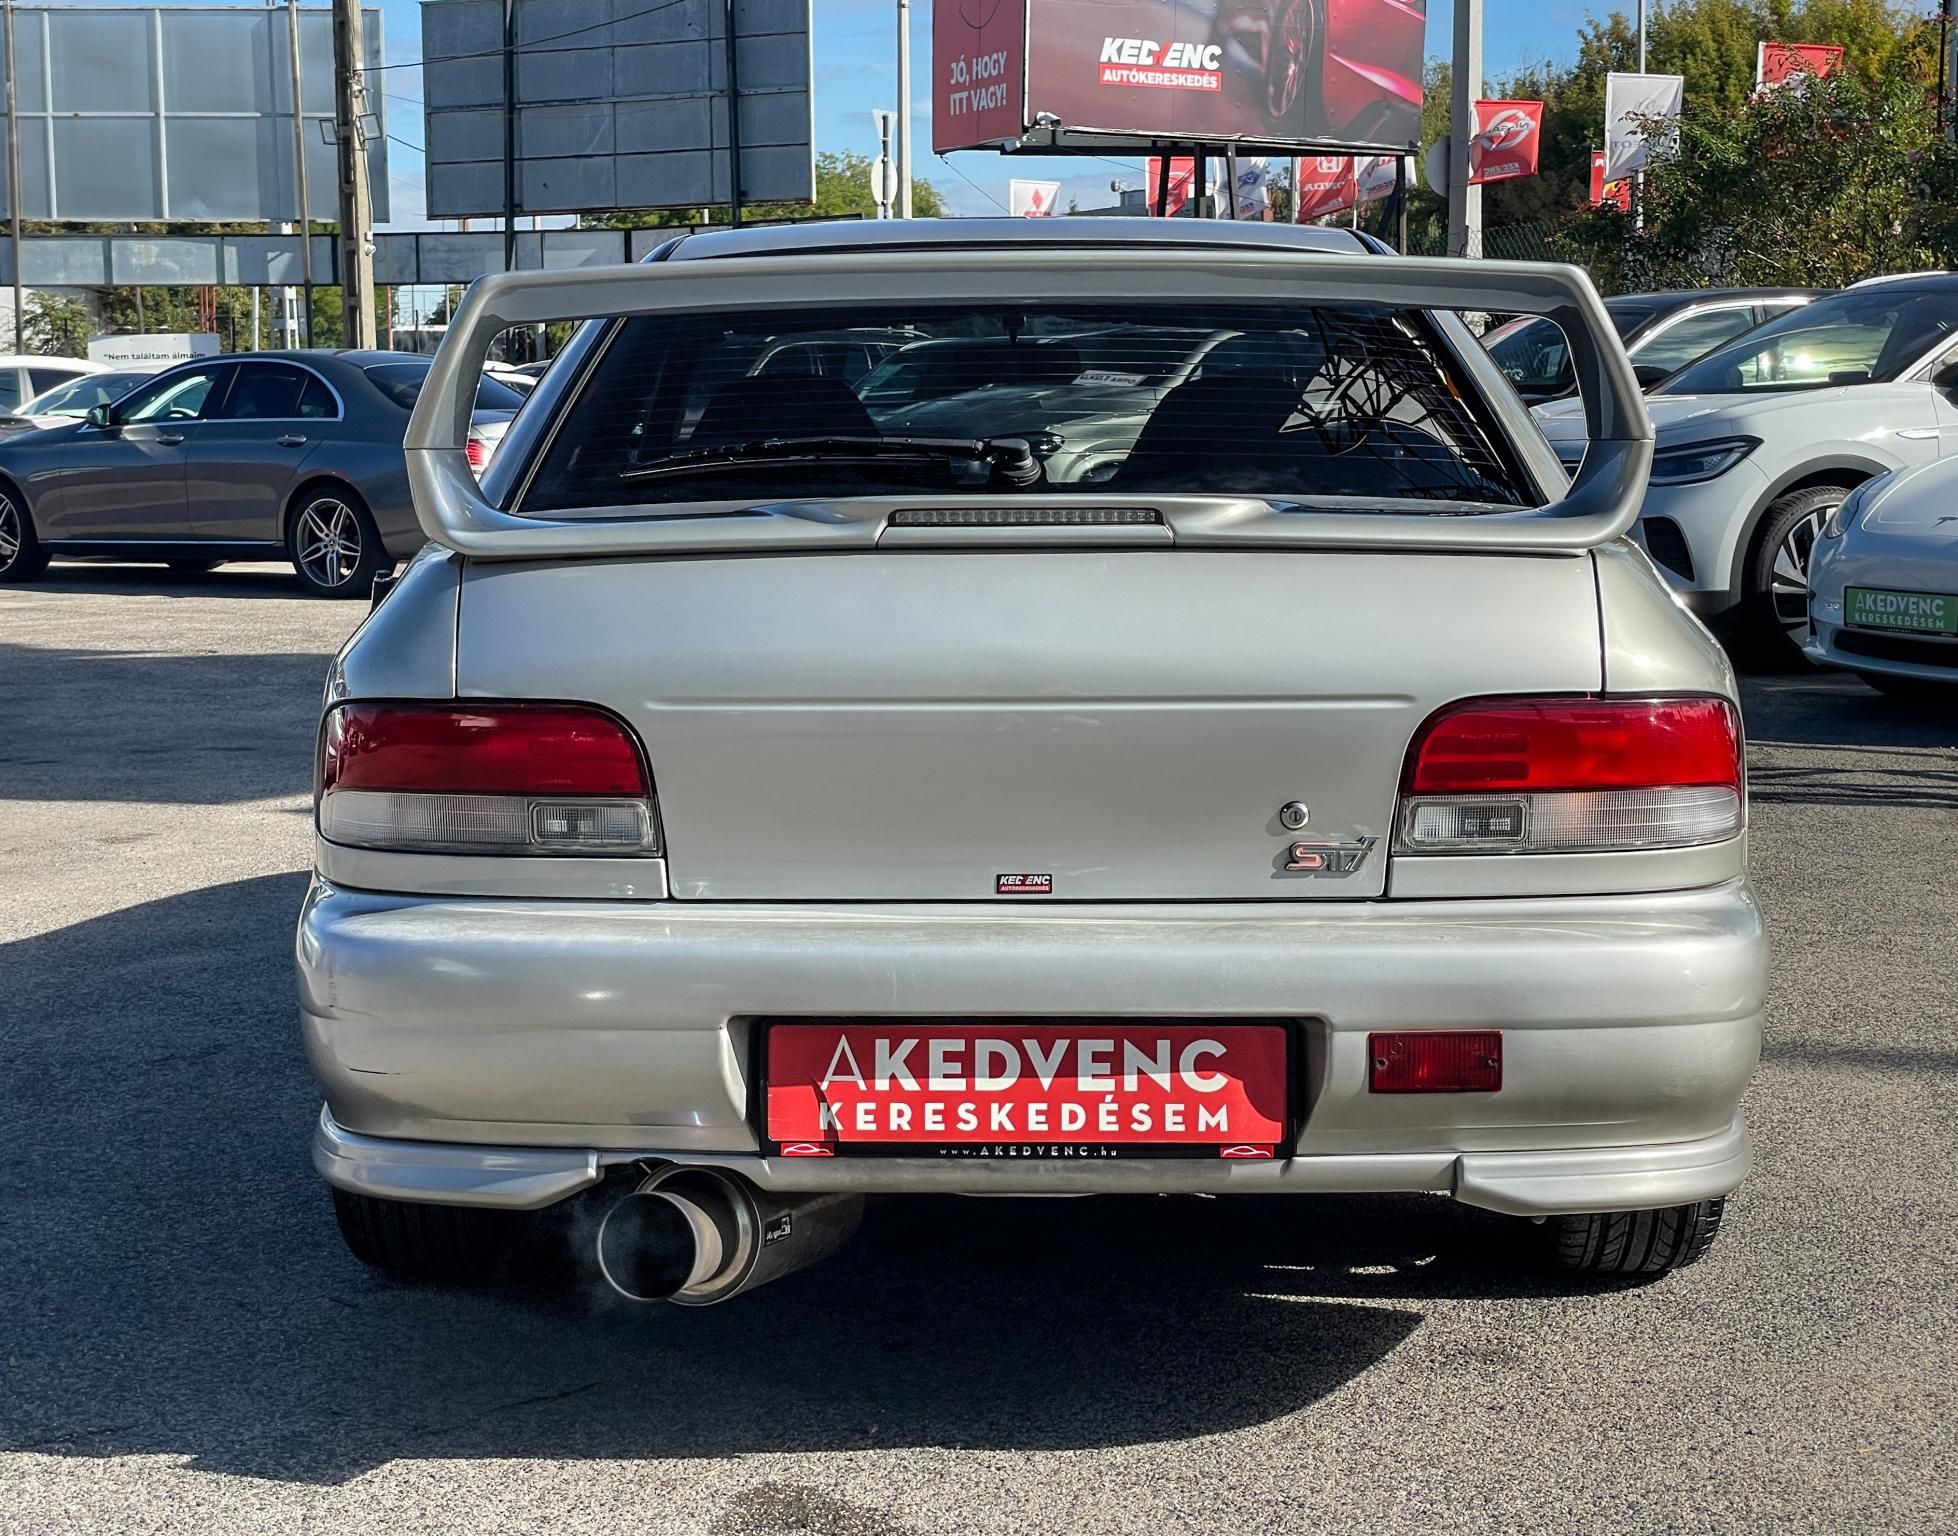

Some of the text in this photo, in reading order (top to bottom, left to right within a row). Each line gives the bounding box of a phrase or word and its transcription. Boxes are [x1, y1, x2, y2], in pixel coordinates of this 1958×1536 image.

[950, 51, 1007, 87] JÓ, HOGY
[1103, 68, 1218, 88] AUTÓKERESKEDÉS
[950, 83, 1007, 116] ITT VAGY!
[103, 352, 129, 361] "Nem
[131, 351, 170, 360] találtam
[1855, 592, 1944, 616] AKEDVENC
[1854, 612, 1944, 629] KERESKEDÉSEM
[820, 1033, 1229, 1093] AKEDVENC
[818, 1093, 1229, 1133] KERESKEDÉSEM
[940, 1145, 1117, 1156] www.AKEDVENC.hu
